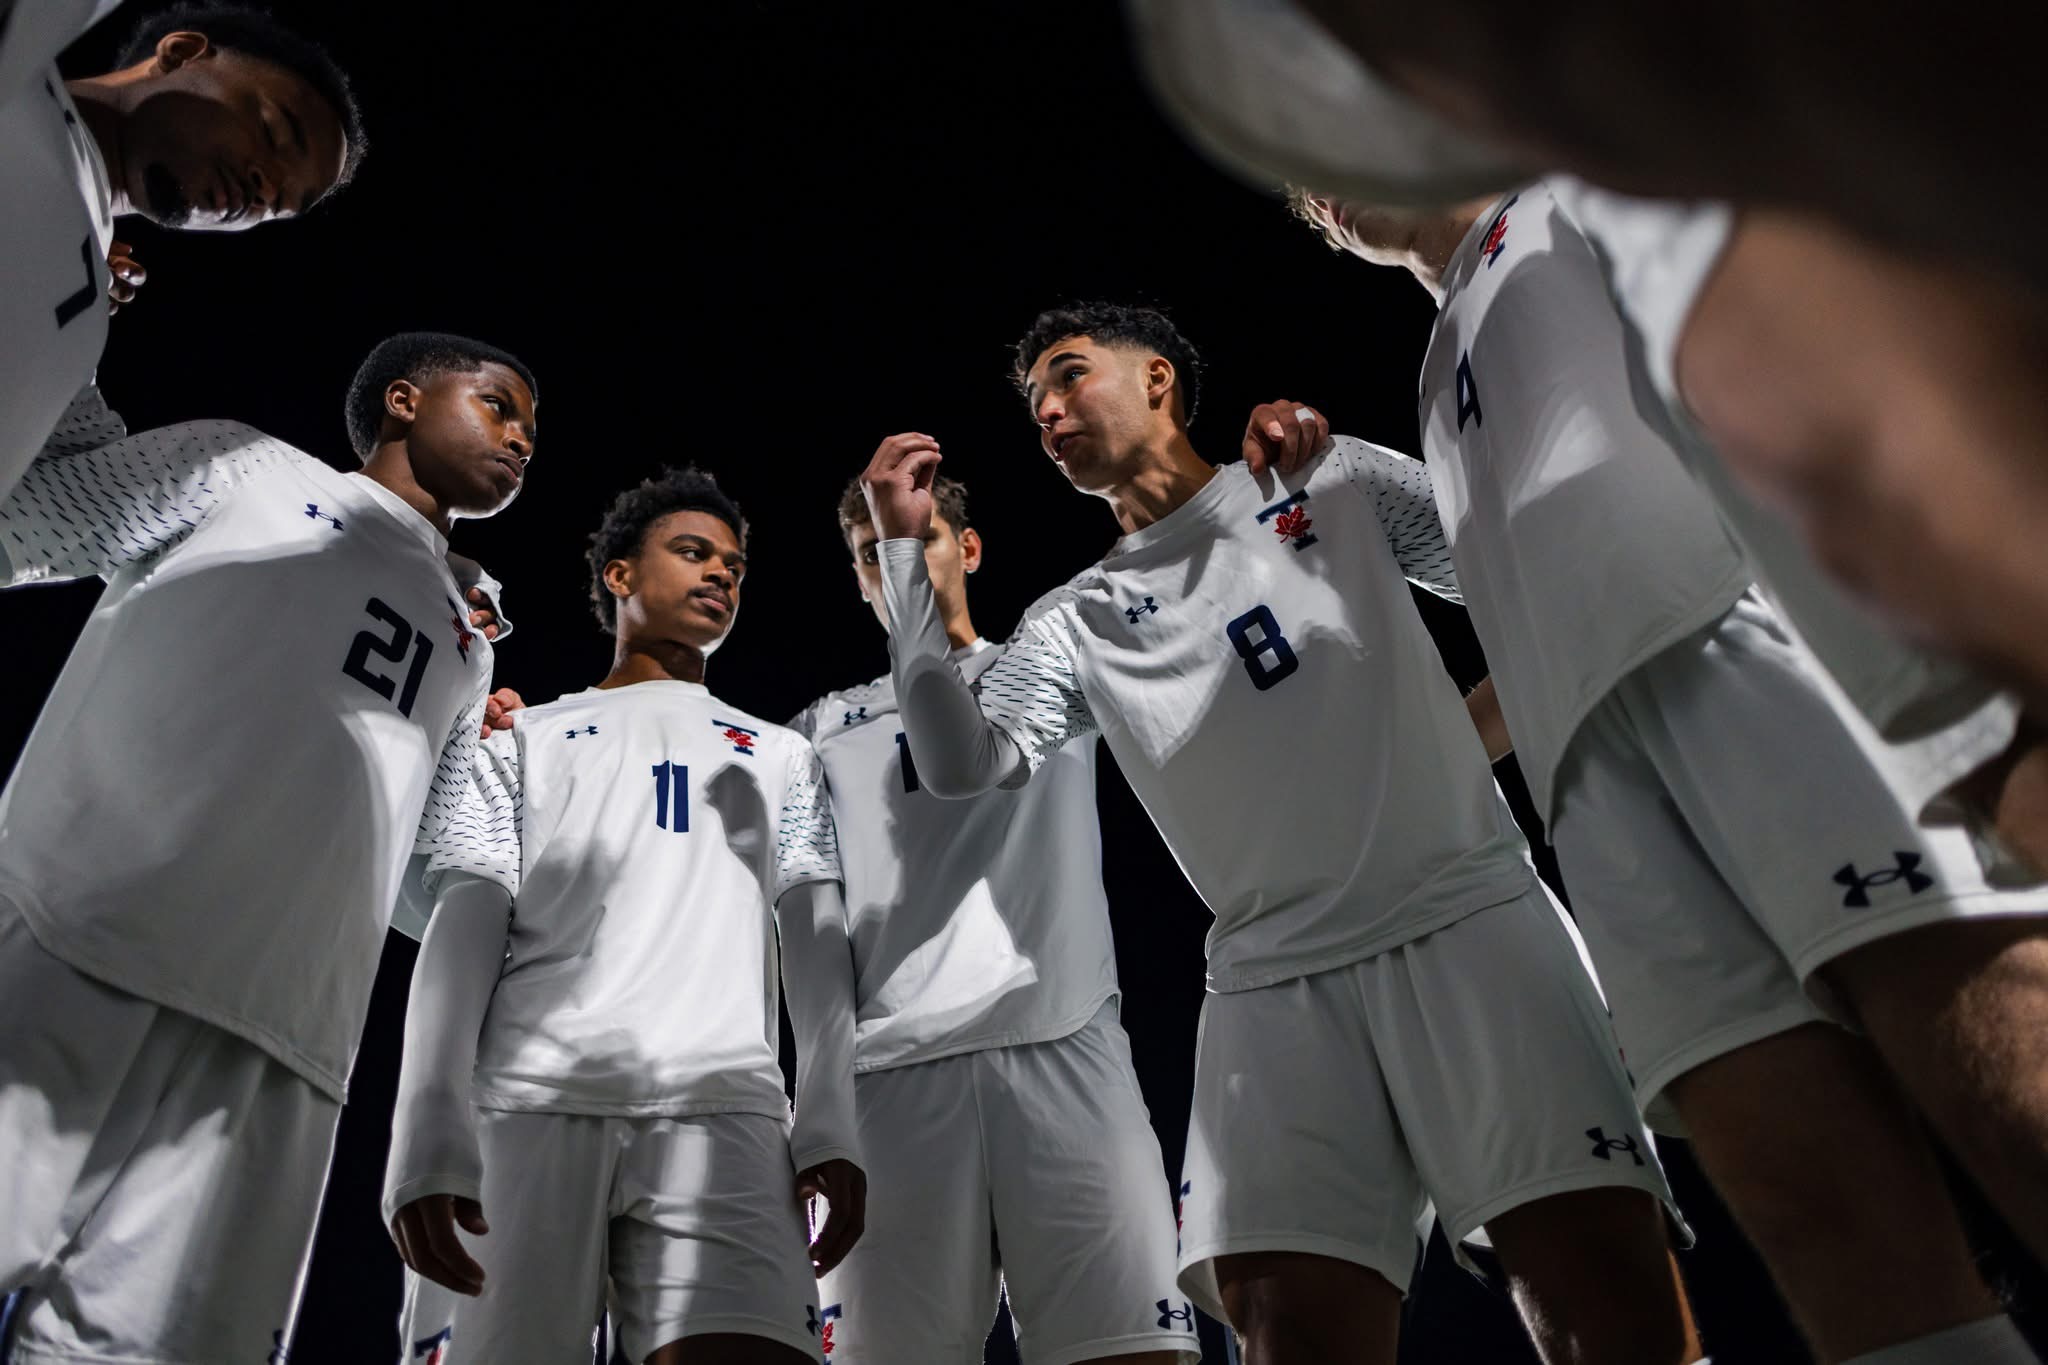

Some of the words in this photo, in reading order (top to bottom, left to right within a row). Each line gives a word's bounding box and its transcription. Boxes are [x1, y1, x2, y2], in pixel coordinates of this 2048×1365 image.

[342, 597, 434, 719] 21
[1226, 604, 1299, 691] 8
[651, 760, 689, 833] 11
